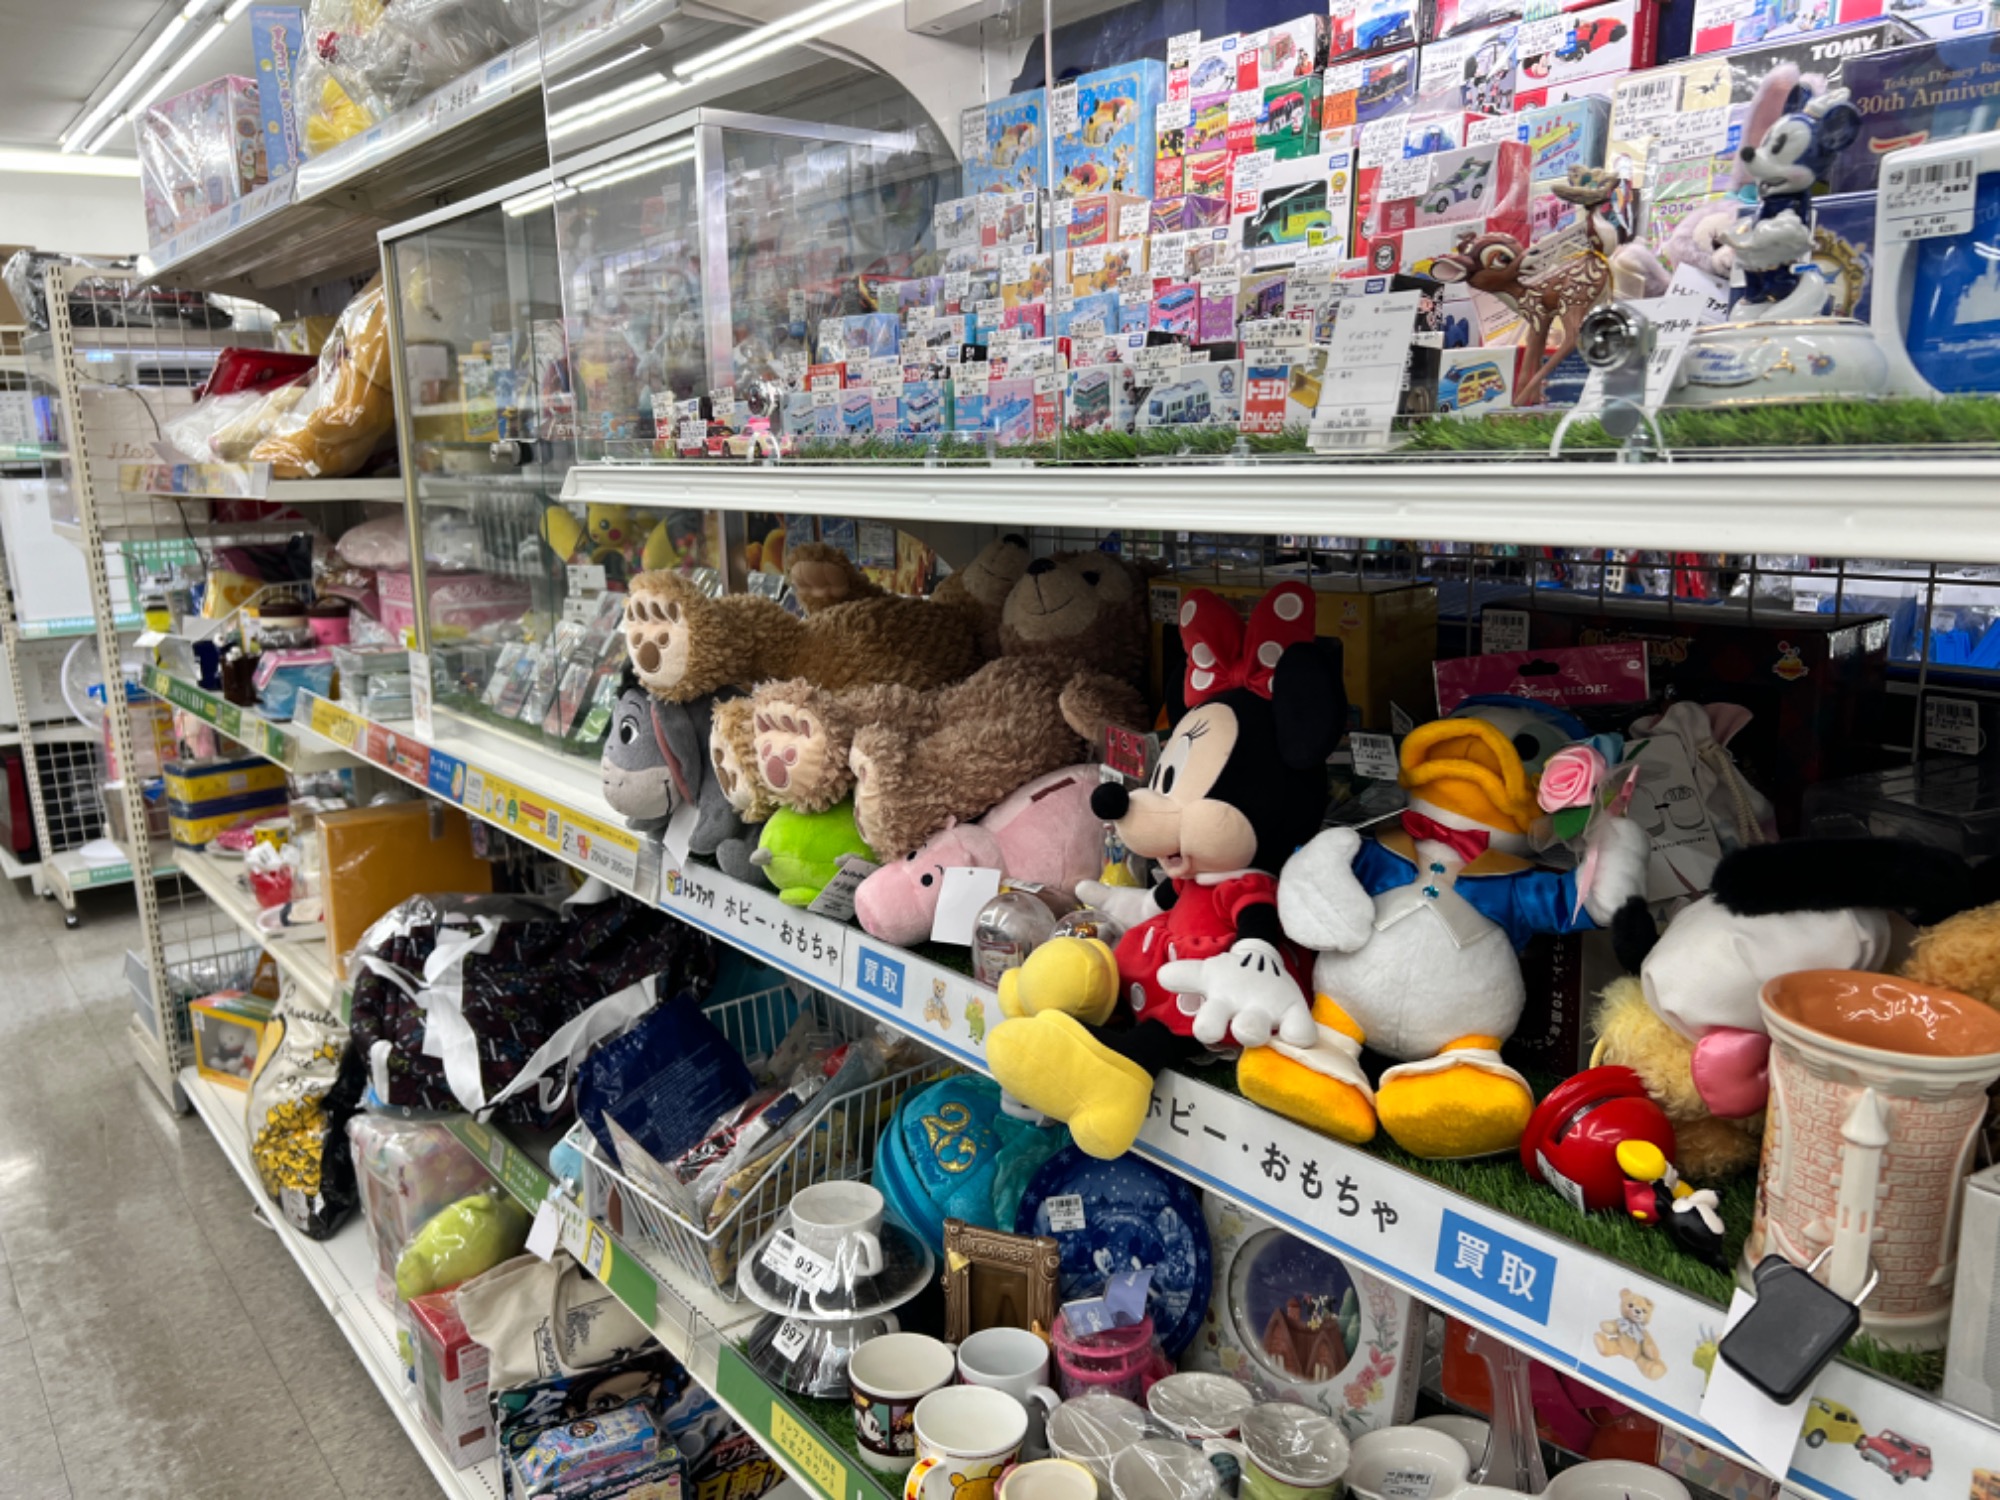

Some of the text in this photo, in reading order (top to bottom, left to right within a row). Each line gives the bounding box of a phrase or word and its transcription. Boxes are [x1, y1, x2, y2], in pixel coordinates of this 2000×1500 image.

[1811, 36, 1877, 60] TOMY
[1883, 75, 1927, 92] Tokyo
[1927, 66, 1978, 89] Disney
[1858, 93, 1905, 117] 30th
[1247, 381, 1285, 400] トミカ
[1564, 684, 1608, 697] RESORT
[724, 896, 839, 967] ホビー・おもちゃ
[864, 955, 899, 996] 買取
[794, 1255, 823, 1280] 997
[1453, 1229, 1538, 1303] 買取
[781, 1322, 805, 1347] 997
